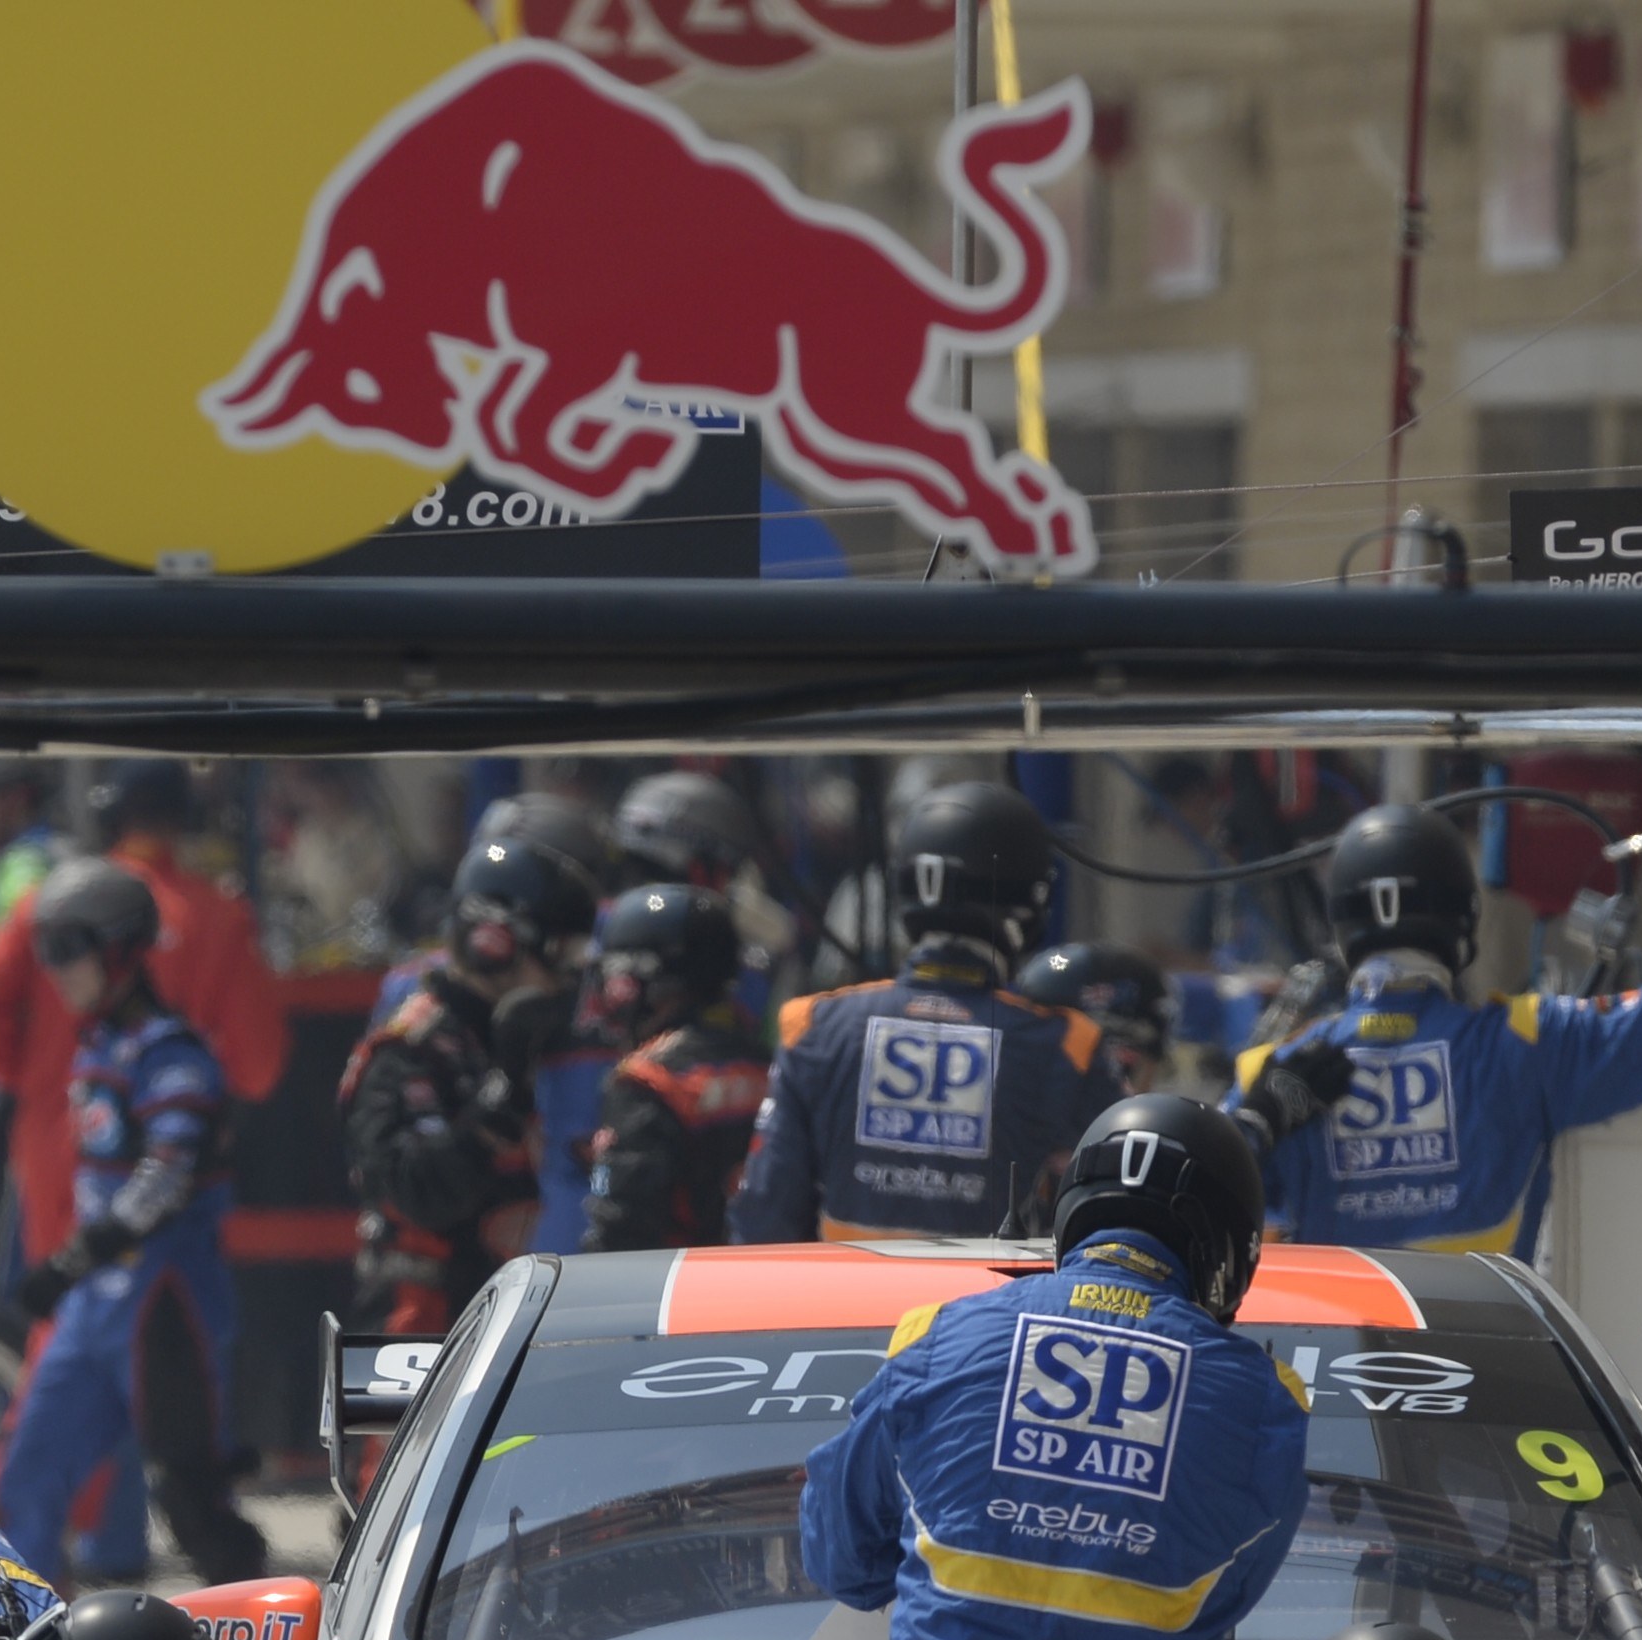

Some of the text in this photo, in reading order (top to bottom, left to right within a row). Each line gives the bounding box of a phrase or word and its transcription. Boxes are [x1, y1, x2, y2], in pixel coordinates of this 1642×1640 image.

[876, 1036, 986, 1103] SP
[1339, 1057, 1441, 1130] SP
[1070, 1283, 1152, 1308] IRWIN
[1091, 1301, 1148, 1319] RACING
[1018, 1332, 1173, 1430] SP
[1349, 1388, 1469, 1414] V8
[1012, 1427, 1156, 1483] SP AIR
[1516, 1430, 1605, 1502] 9
[986, 1499, 1157, 1545] erebus
[1010, 1523, 1123, 1549] motorsport
